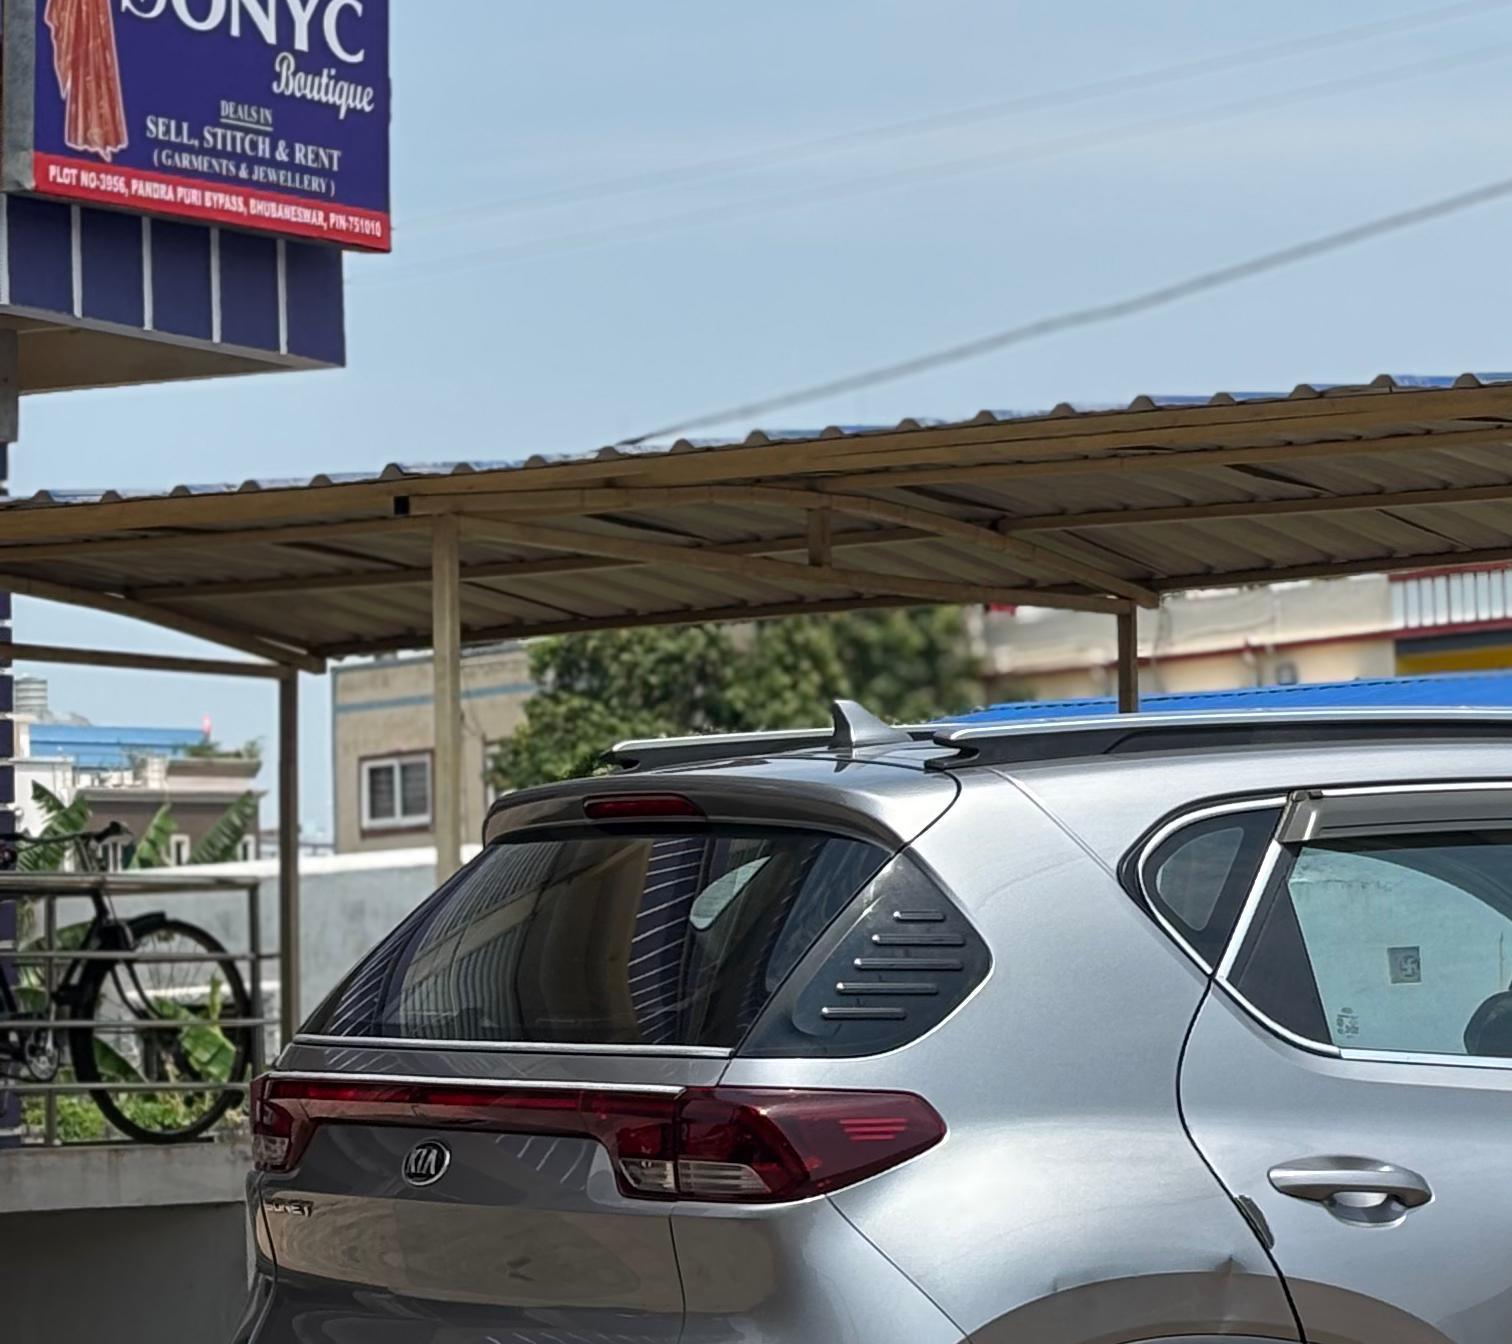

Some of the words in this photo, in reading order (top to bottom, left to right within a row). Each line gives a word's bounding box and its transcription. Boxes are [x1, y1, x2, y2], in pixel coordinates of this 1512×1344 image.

[272, 52, 375, 120] Boutique
[220, 100, 257, 123] DEALS
[259, 107, 273, 124] IN
[146, 115, 199, 147] SELL,
[203, 126, 271, 159] STITCH
[275, 140, 289, 162] &
[294, 143, 341, 172] RENT
[161, 149, 236, 177] GARMENTS
[238, 163, 249, 179] &
[252, 166, 328, 193] JEWELLERY
[49, 165, 78, 185] PLOT
[176, 186, 202, 205] PURI
[204, 190, 248, 216] BYPASS,
[250, 198, 327, 230] BHUBANESWAR,
[406, 1148, 438, 1175] KIA
